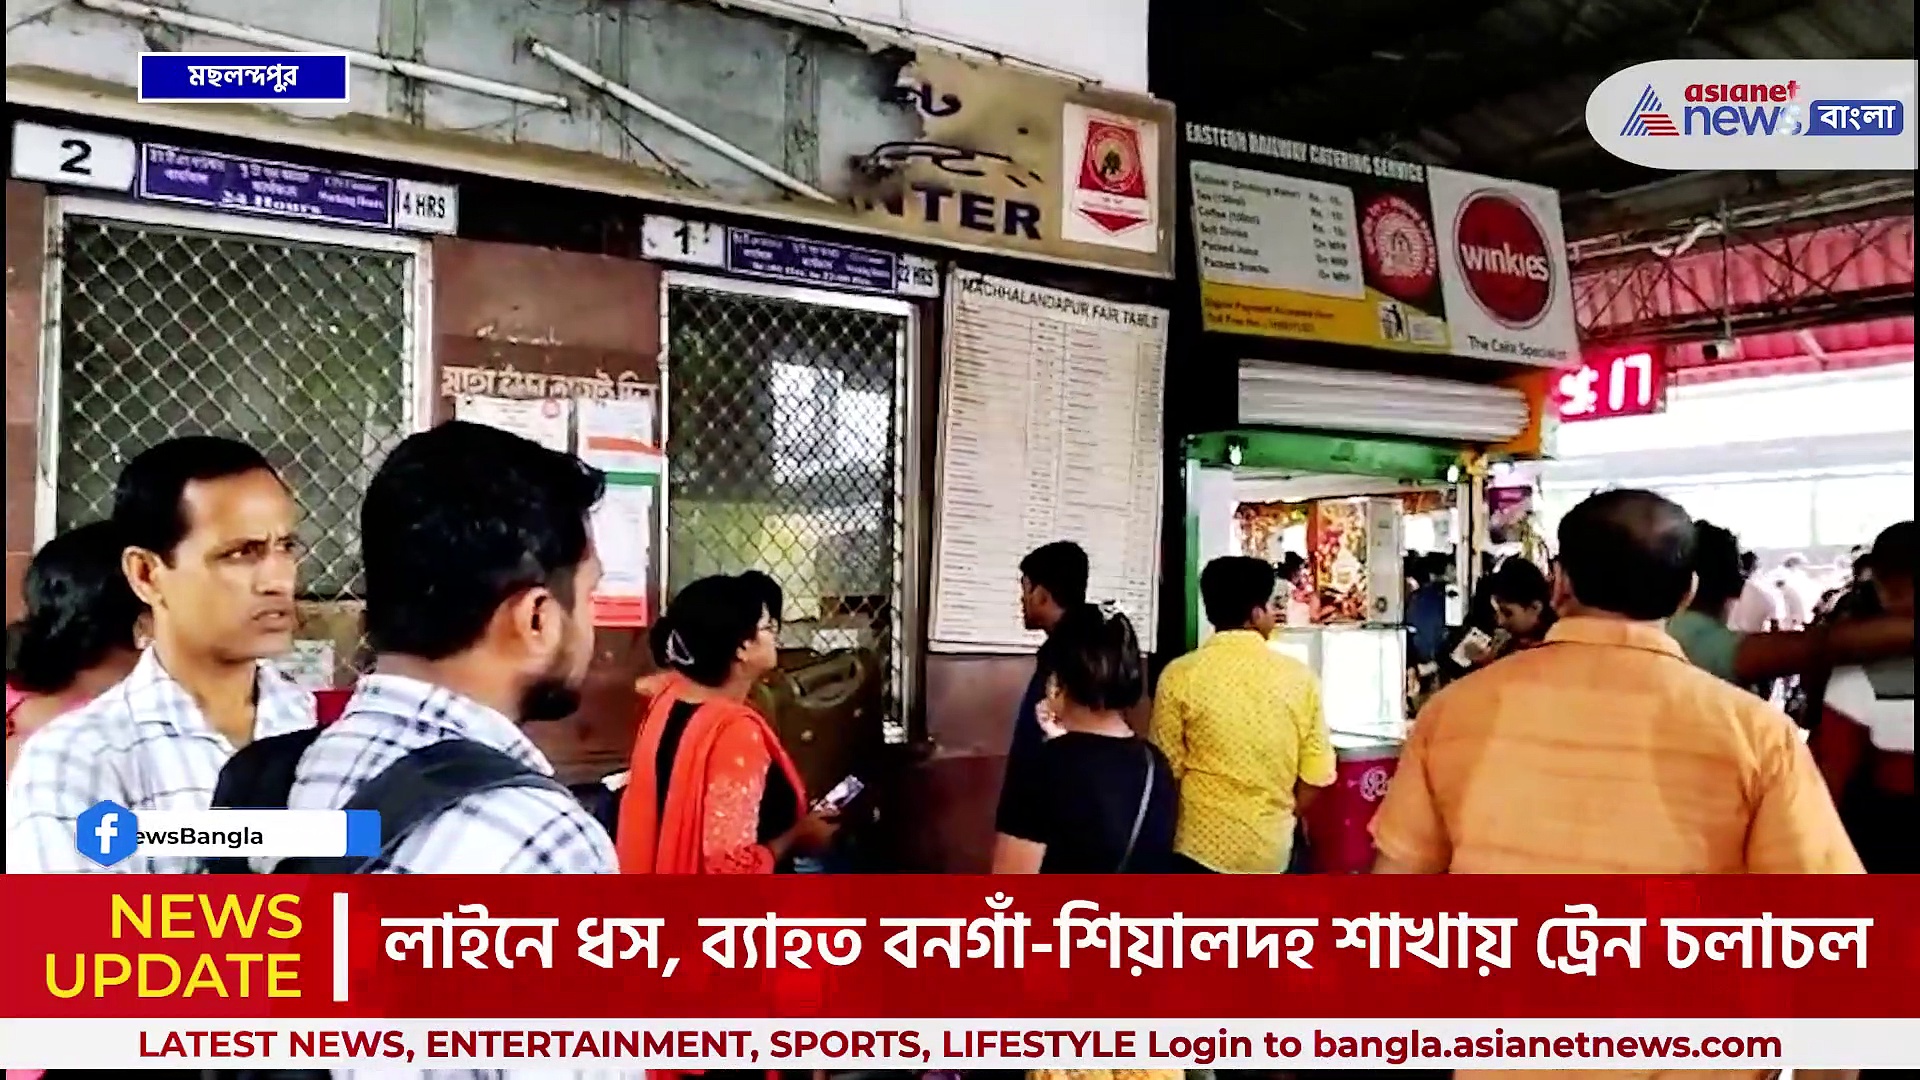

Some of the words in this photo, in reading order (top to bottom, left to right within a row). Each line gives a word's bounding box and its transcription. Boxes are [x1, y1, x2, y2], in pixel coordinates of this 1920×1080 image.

[61, 140, 92, 175] 2
[1185, 121, 1248, 153] EASTERN
[1309, 143, 1372, 176] CATERING
[1372, 155, 1424, 184] SERVICE
[416, 192, 446, 219] HRS
[1460, 242, 1549, 282] winkies
[1092, 304, 1119, 324] FAIR
[1122, 310, 1159, 329] TABLE
[1468, 335, 1489, 351] The
